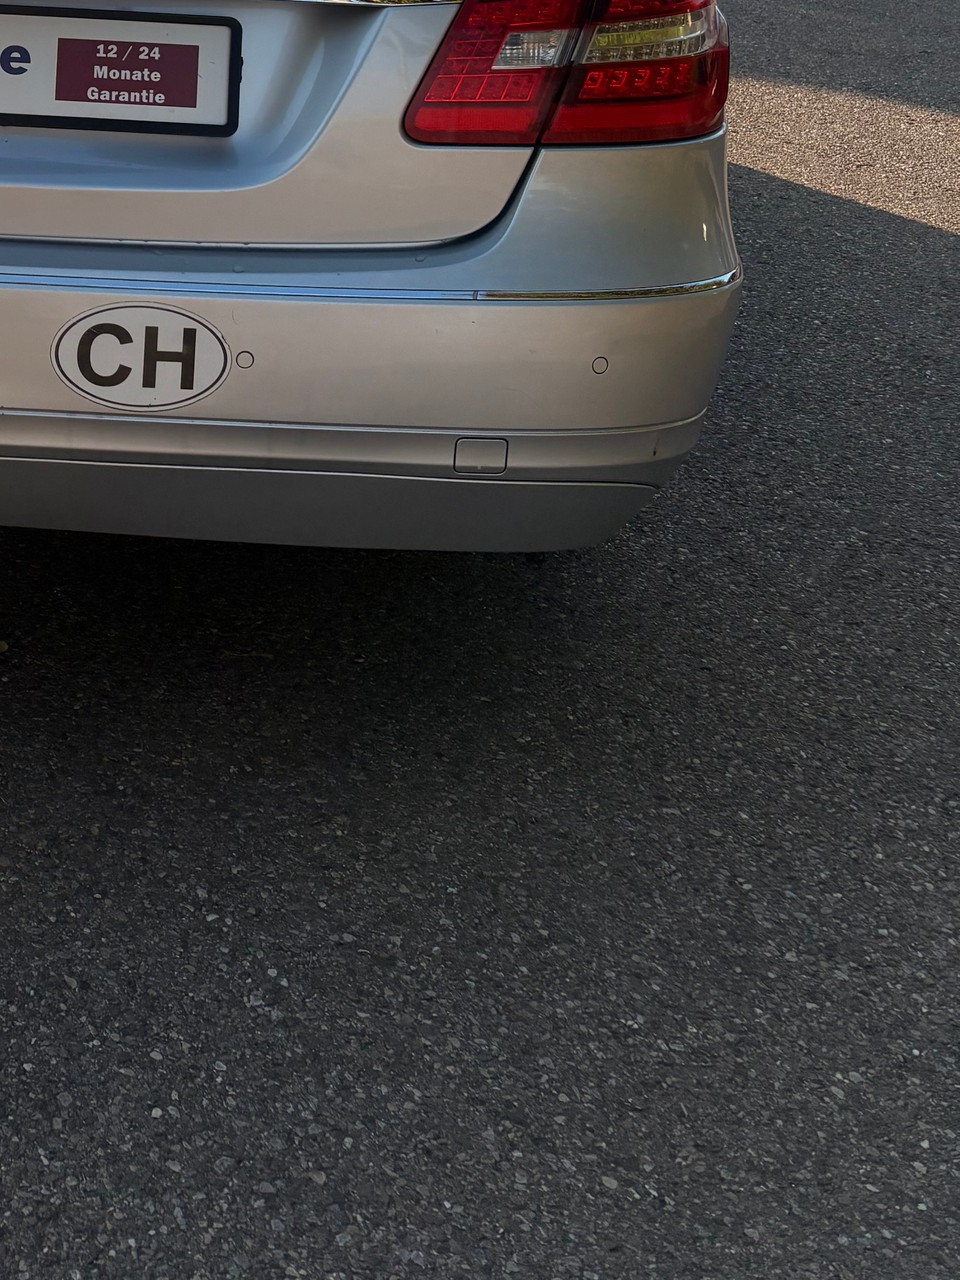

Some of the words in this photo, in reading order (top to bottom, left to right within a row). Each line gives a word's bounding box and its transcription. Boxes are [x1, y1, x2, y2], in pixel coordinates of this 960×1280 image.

[96, 43, 118, 58] 12
[122, 45, 133, 61] /
[138, 46, 161, 60] 24
[93, 65, 162, 82] Monate
[86, 86, 166, 104] Garantie
[76, 322, 197, 391] CH
